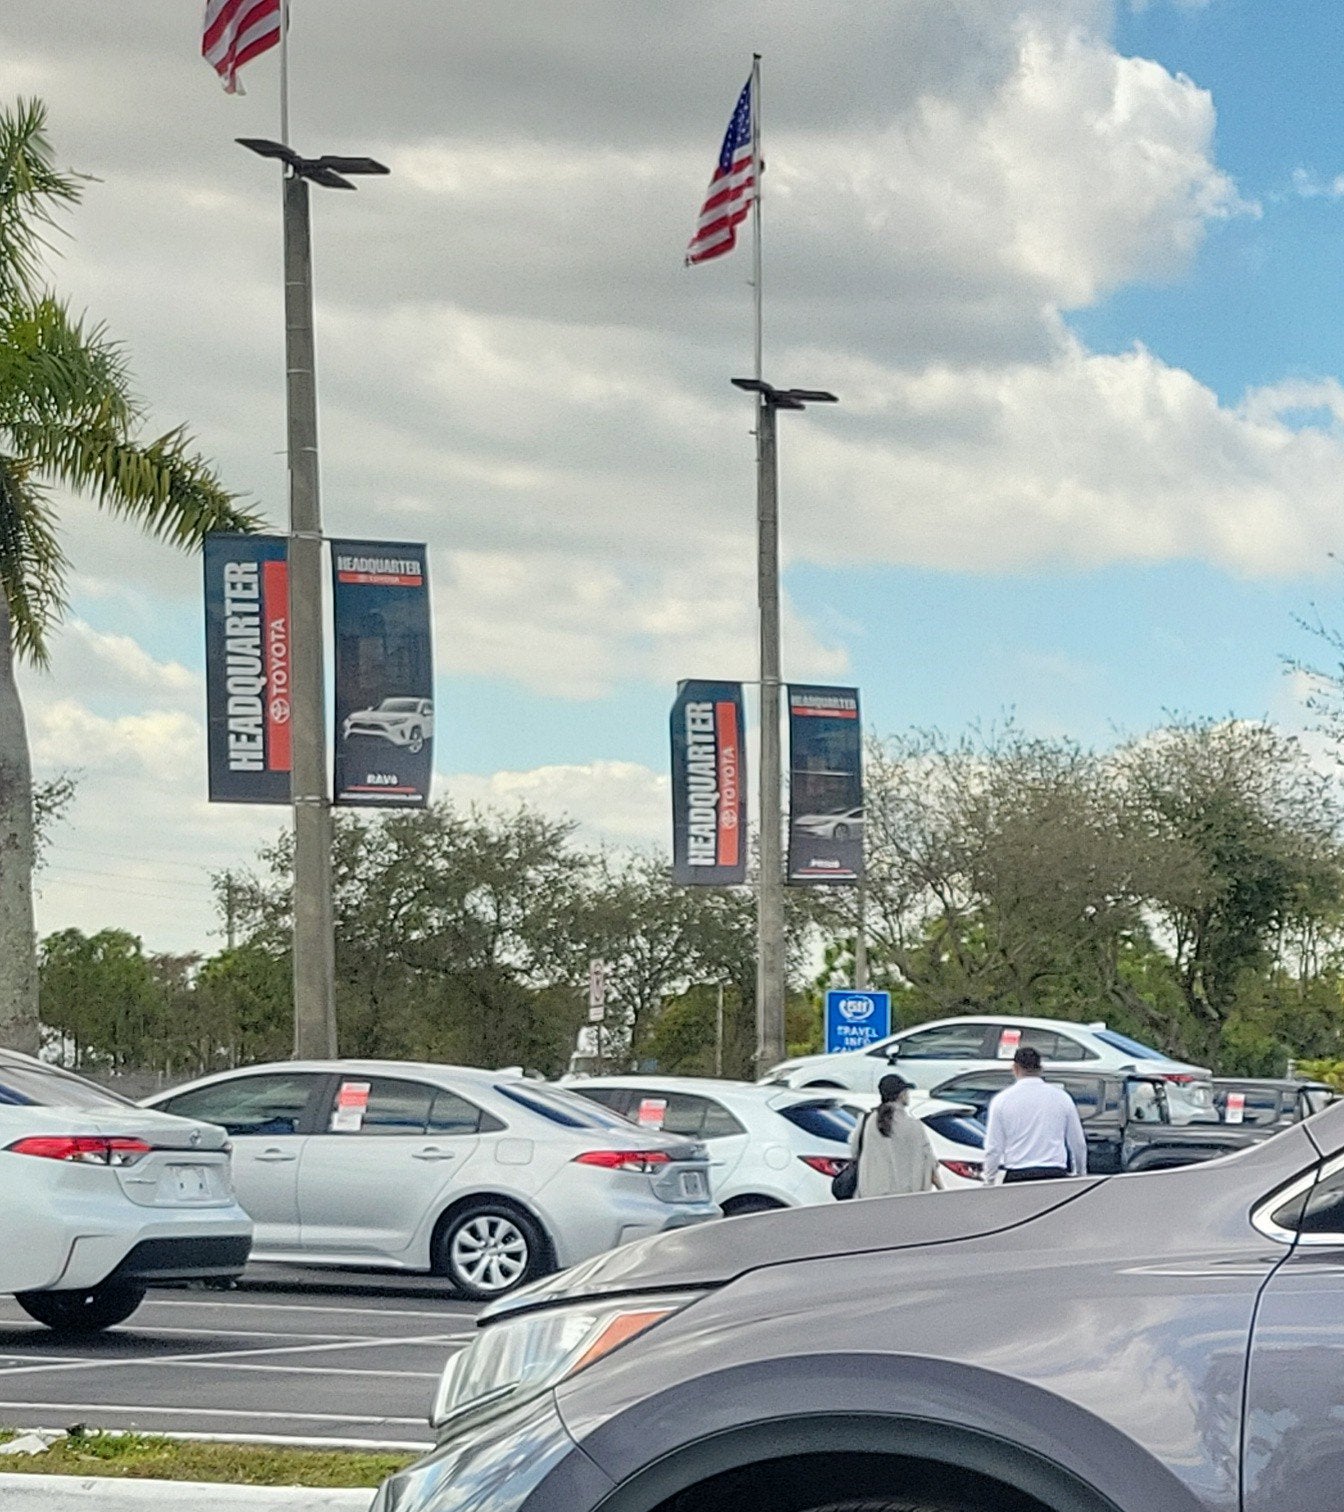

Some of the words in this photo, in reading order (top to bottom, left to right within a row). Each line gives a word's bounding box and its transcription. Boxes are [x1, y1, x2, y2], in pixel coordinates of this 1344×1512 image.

[336, 556, 421, 575] HEADQUARTER
[224, 562, 266, 771] HEADQUARTER
[271, 618, 288, 697] TOYOTA
[685, 701, 719, 866] HEADQUARTER
[719, 747, 737, 808] TOYOTA
[836, 1026, 878, 1037] TRAVEL
